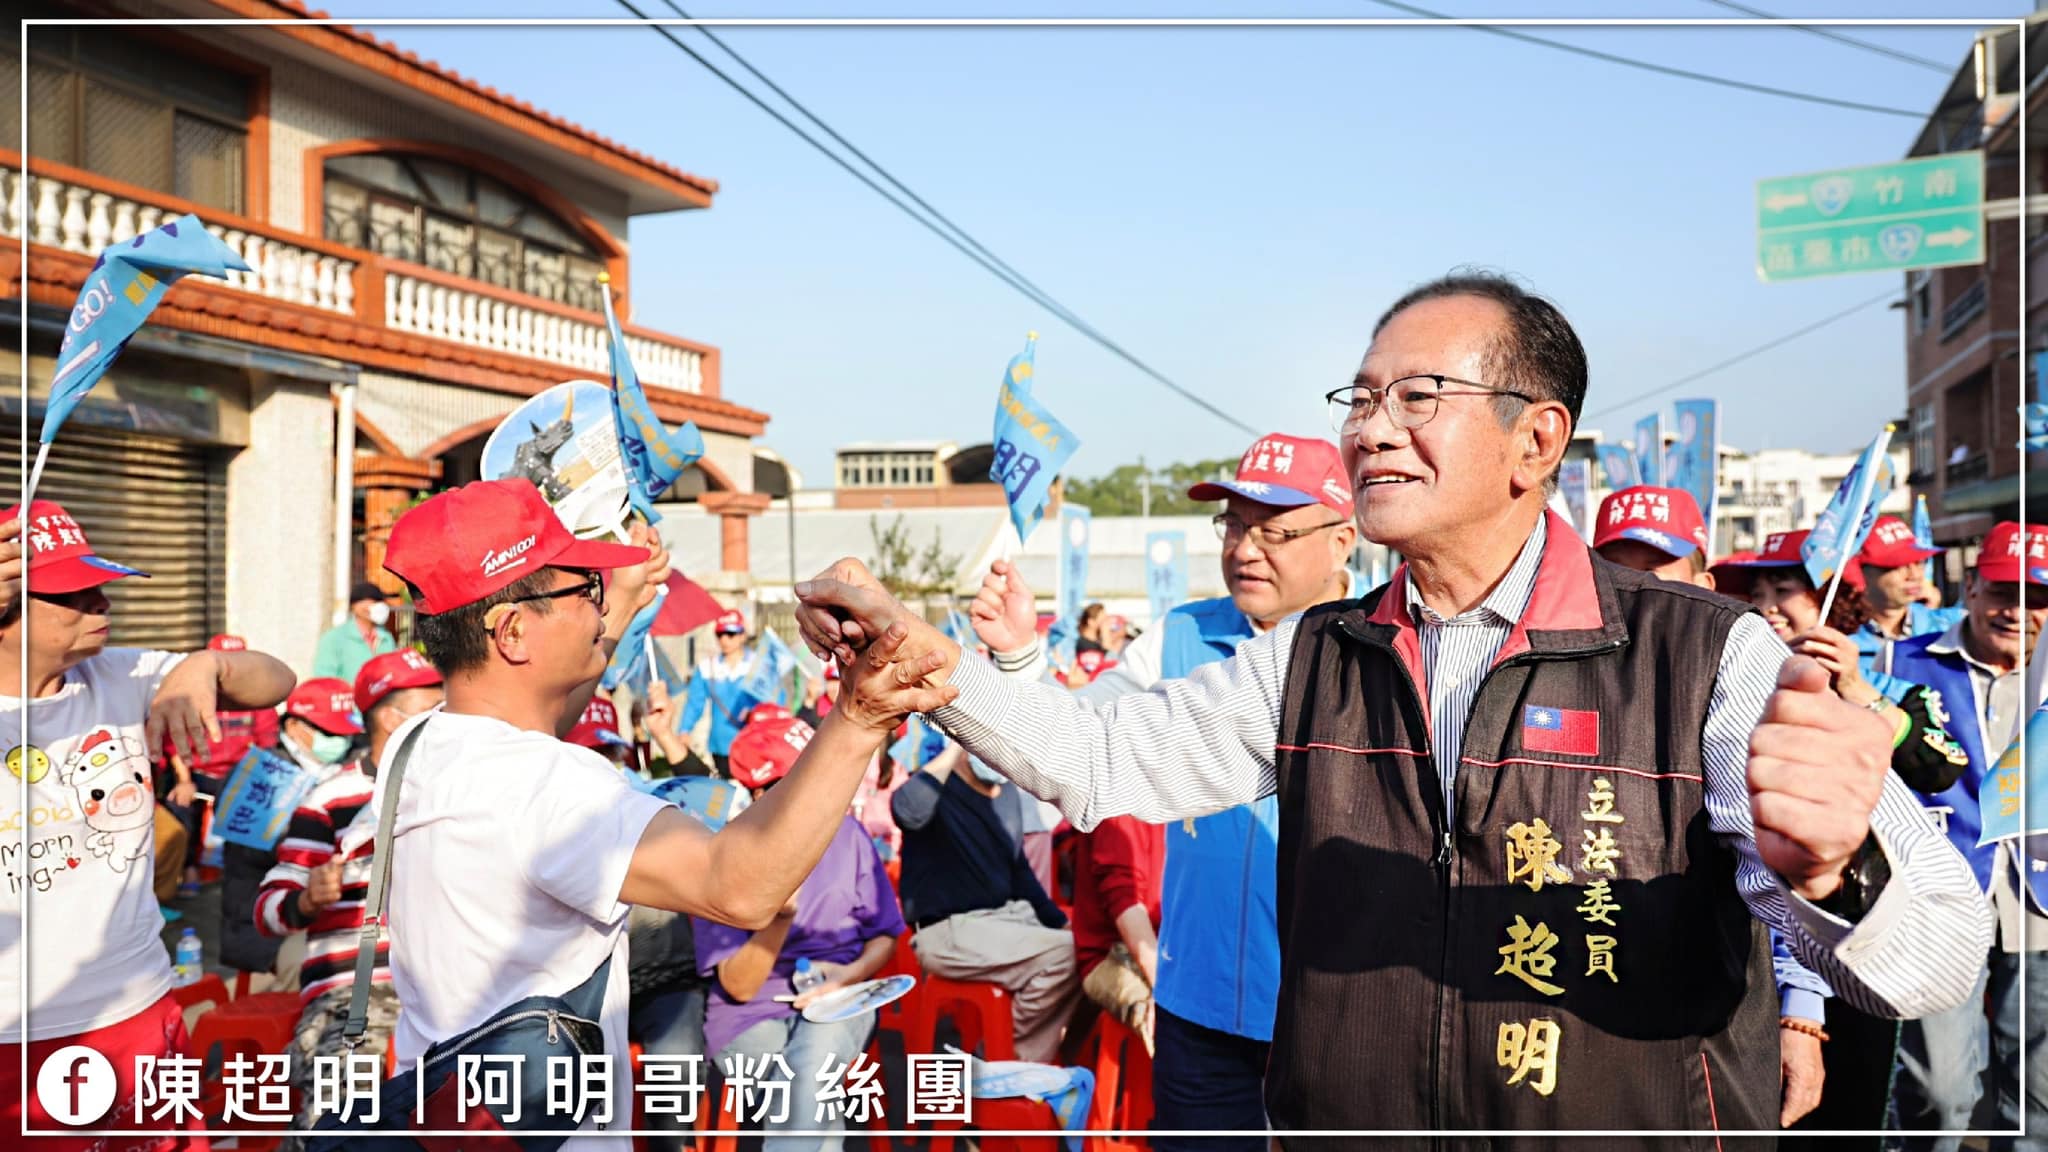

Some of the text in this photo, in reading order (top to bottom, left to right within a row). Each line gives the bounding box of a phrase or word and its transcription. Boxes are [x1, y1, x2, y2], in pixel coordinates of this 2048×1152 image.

[69, 279, 115, 333] GO!
[1494, 817, 1573, 1097] 陳超明
[1576, 777, 1625, 983] 立法委員
